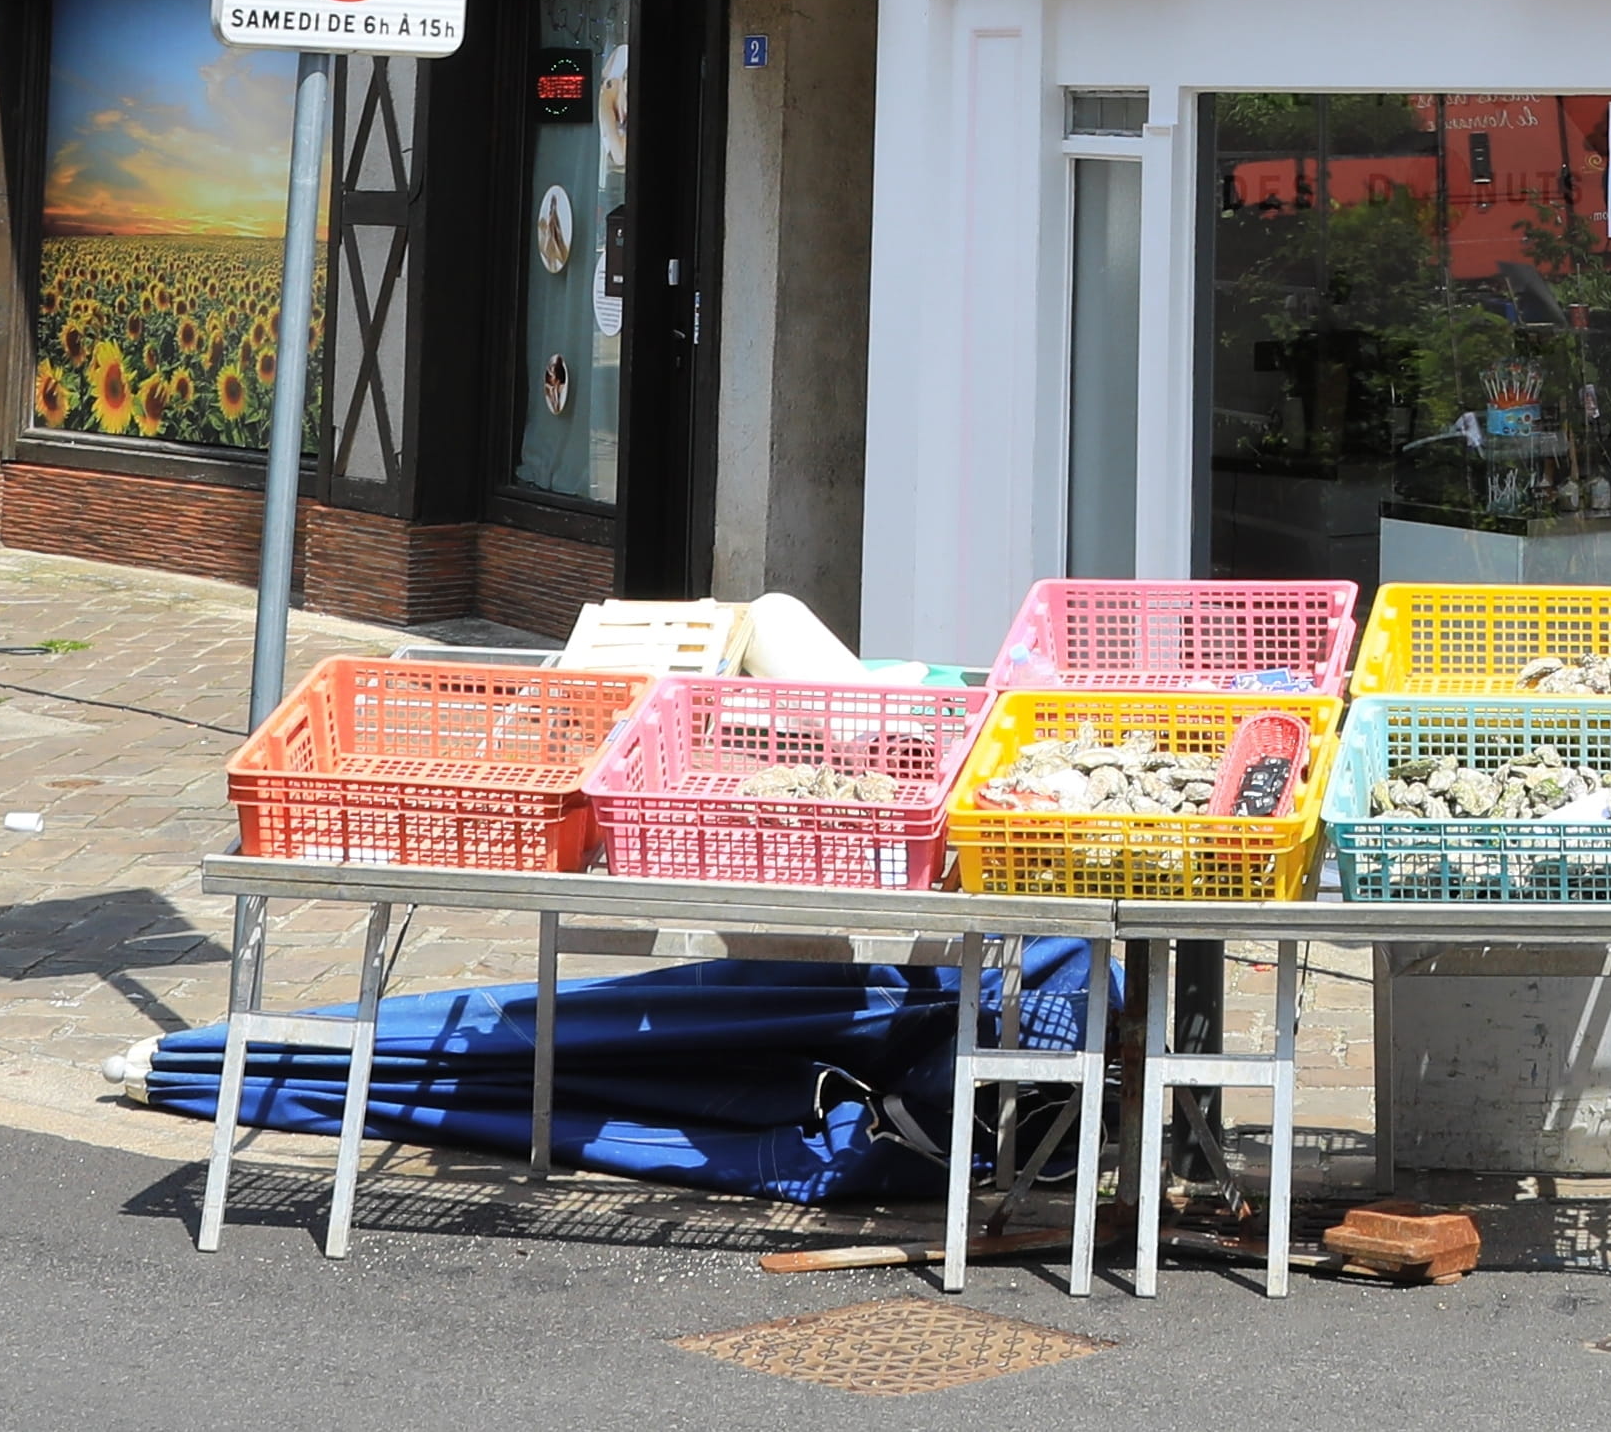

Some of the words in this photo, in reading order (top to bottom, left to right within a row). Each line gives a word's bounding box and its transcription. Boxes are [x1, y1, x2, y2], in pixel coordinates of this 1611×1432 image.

[231, 9, 321, 34] SAMEDI
[327, 13, 356, 35] DE
[362, 14, 390, 36] 6h
[398, 12, 412, 38] À
[419, 17, 455, 40] 15h
[749, 40, 761, 64] 2
